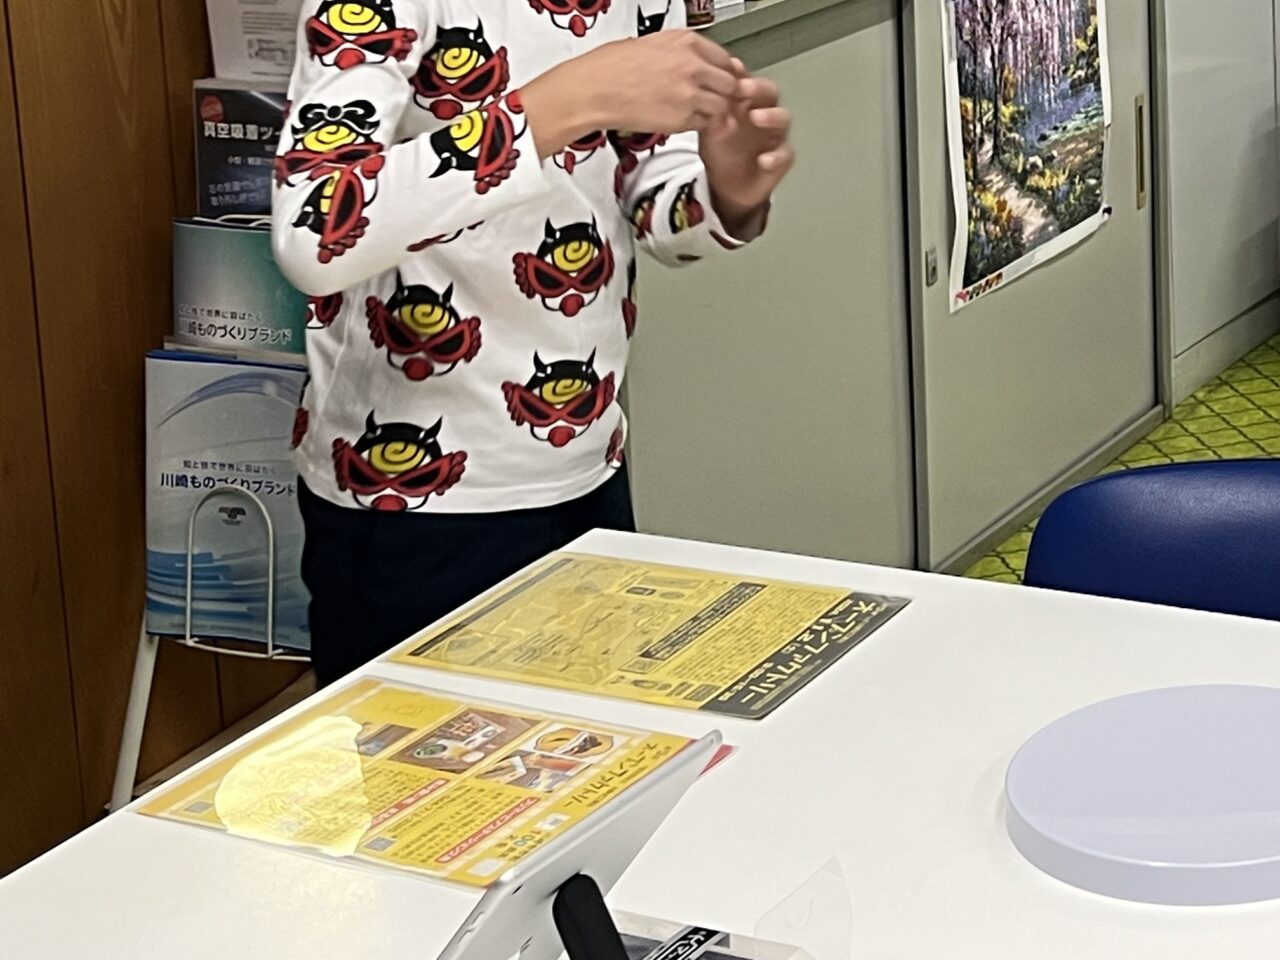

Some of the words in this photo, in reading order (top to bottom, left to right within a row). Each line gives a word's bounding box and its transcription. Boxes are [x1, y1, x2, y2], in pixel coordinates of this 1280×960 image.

[741, 600, 877, 704] オープンファクトリー
